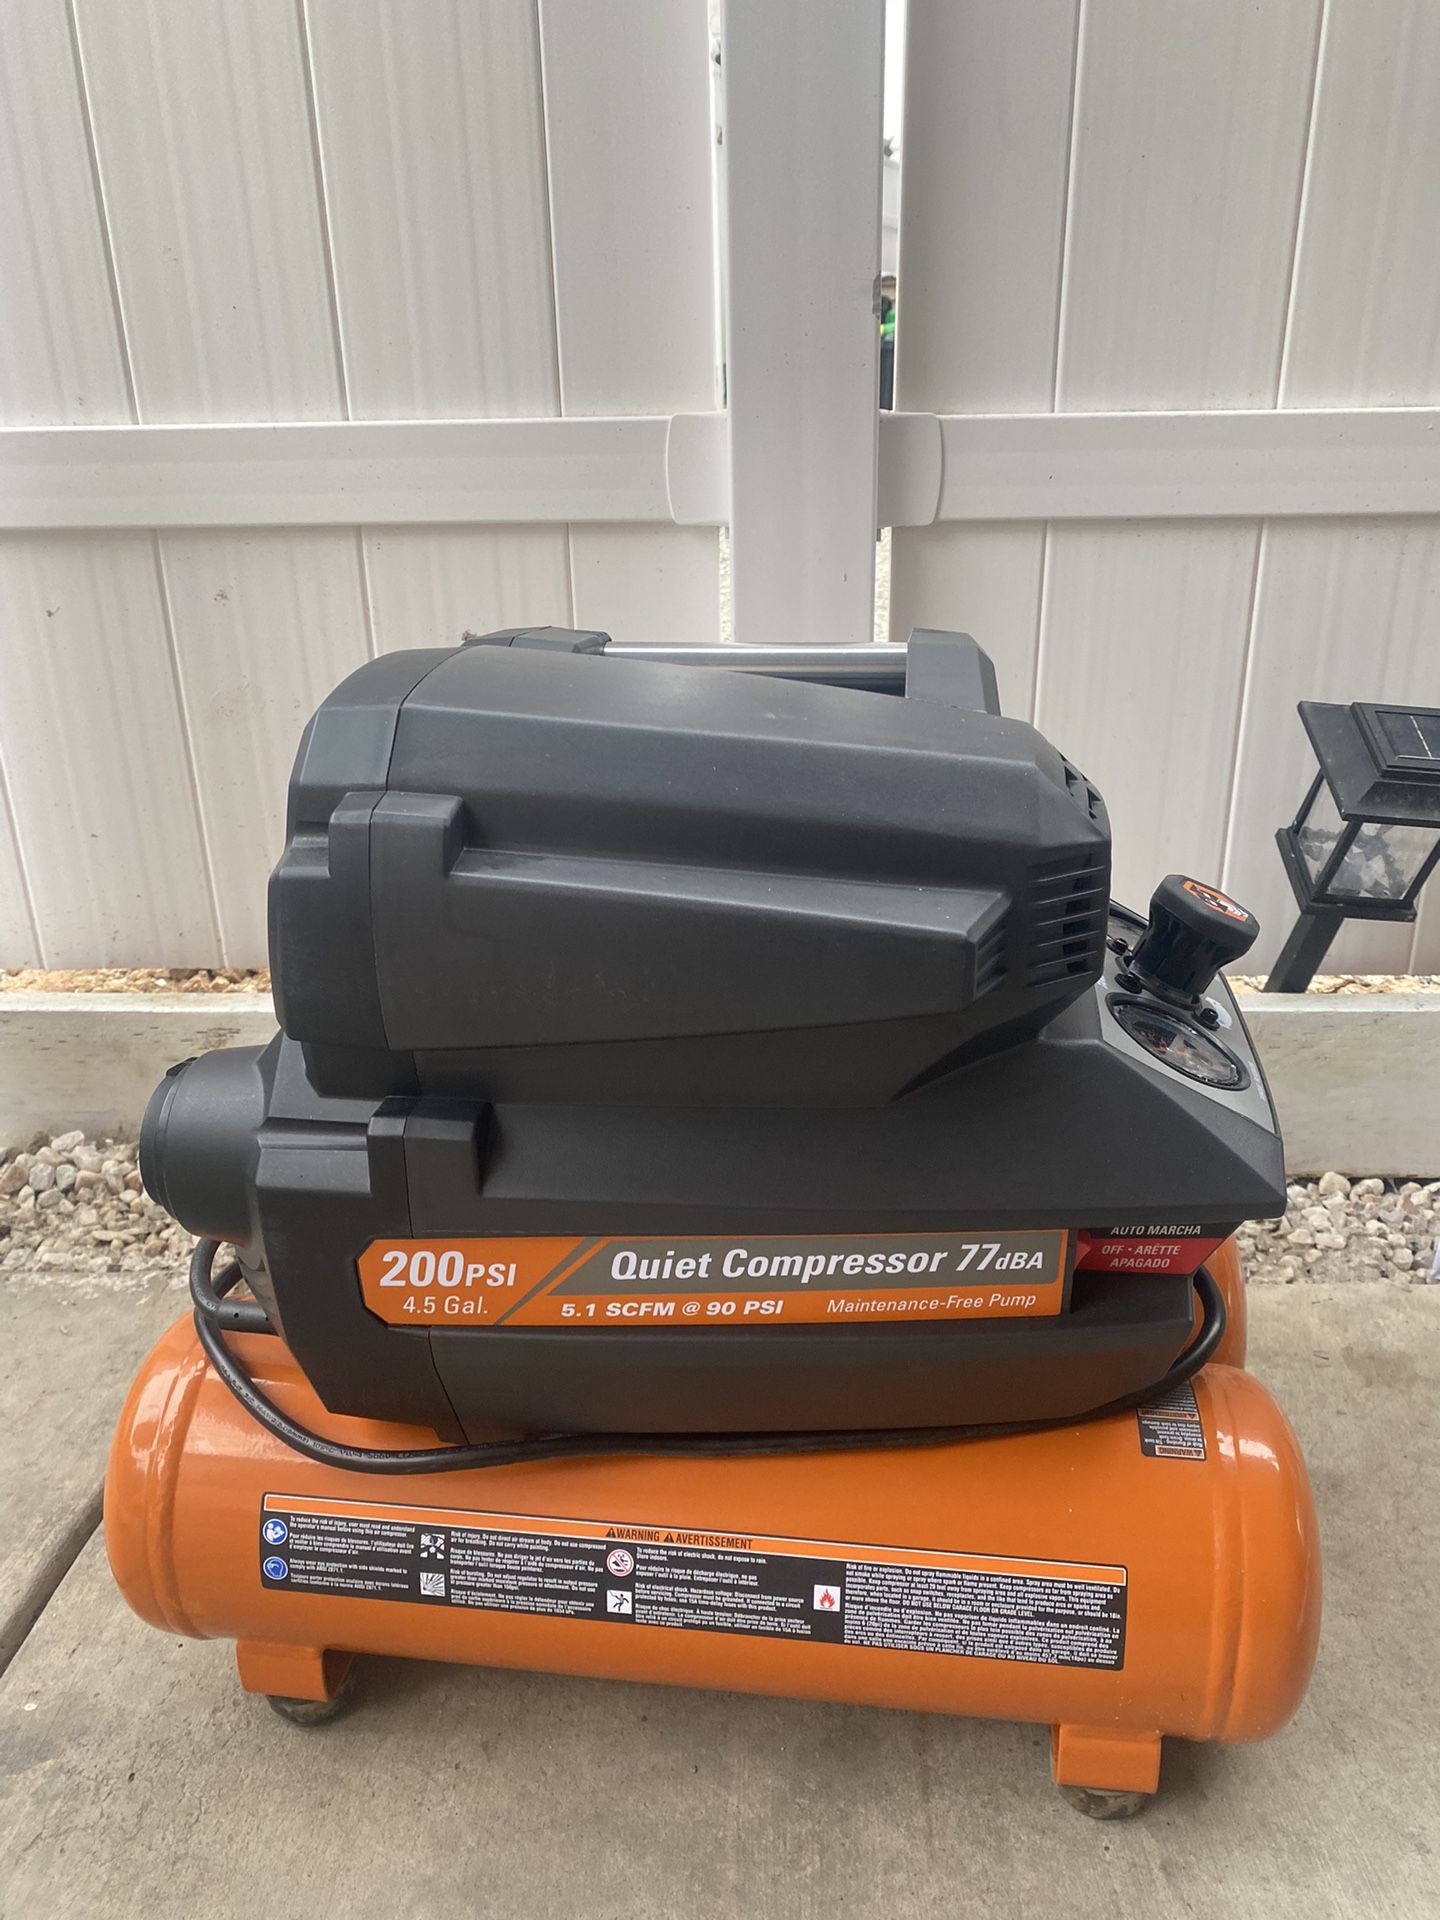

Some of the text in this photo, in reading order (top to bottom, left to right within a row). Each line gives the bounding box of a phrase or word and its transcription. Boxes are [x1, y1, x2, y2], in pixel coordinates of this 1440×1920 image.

[1110, 1225, 1200, 1235] AUTO MARCHA
[1102, 1245, 1125, 1254] OFF
[380, 1250, 517, 1286] 200PSI
[611, 1244, 1044, 1284] Quiet Compressor 77dBA
[1110, 1258, 1170, 1268] APAGADO
[403, 1295, 488, 1314] 4.5 Gal.
[561, 1300, 784, 1317] 5.1 SCFM @ 90 PSI
[827, 1293, 1036, 1313] Maintenance-Free Pump
[617, 1528, 752, 1549] WARNING AVERTISSEMENT
